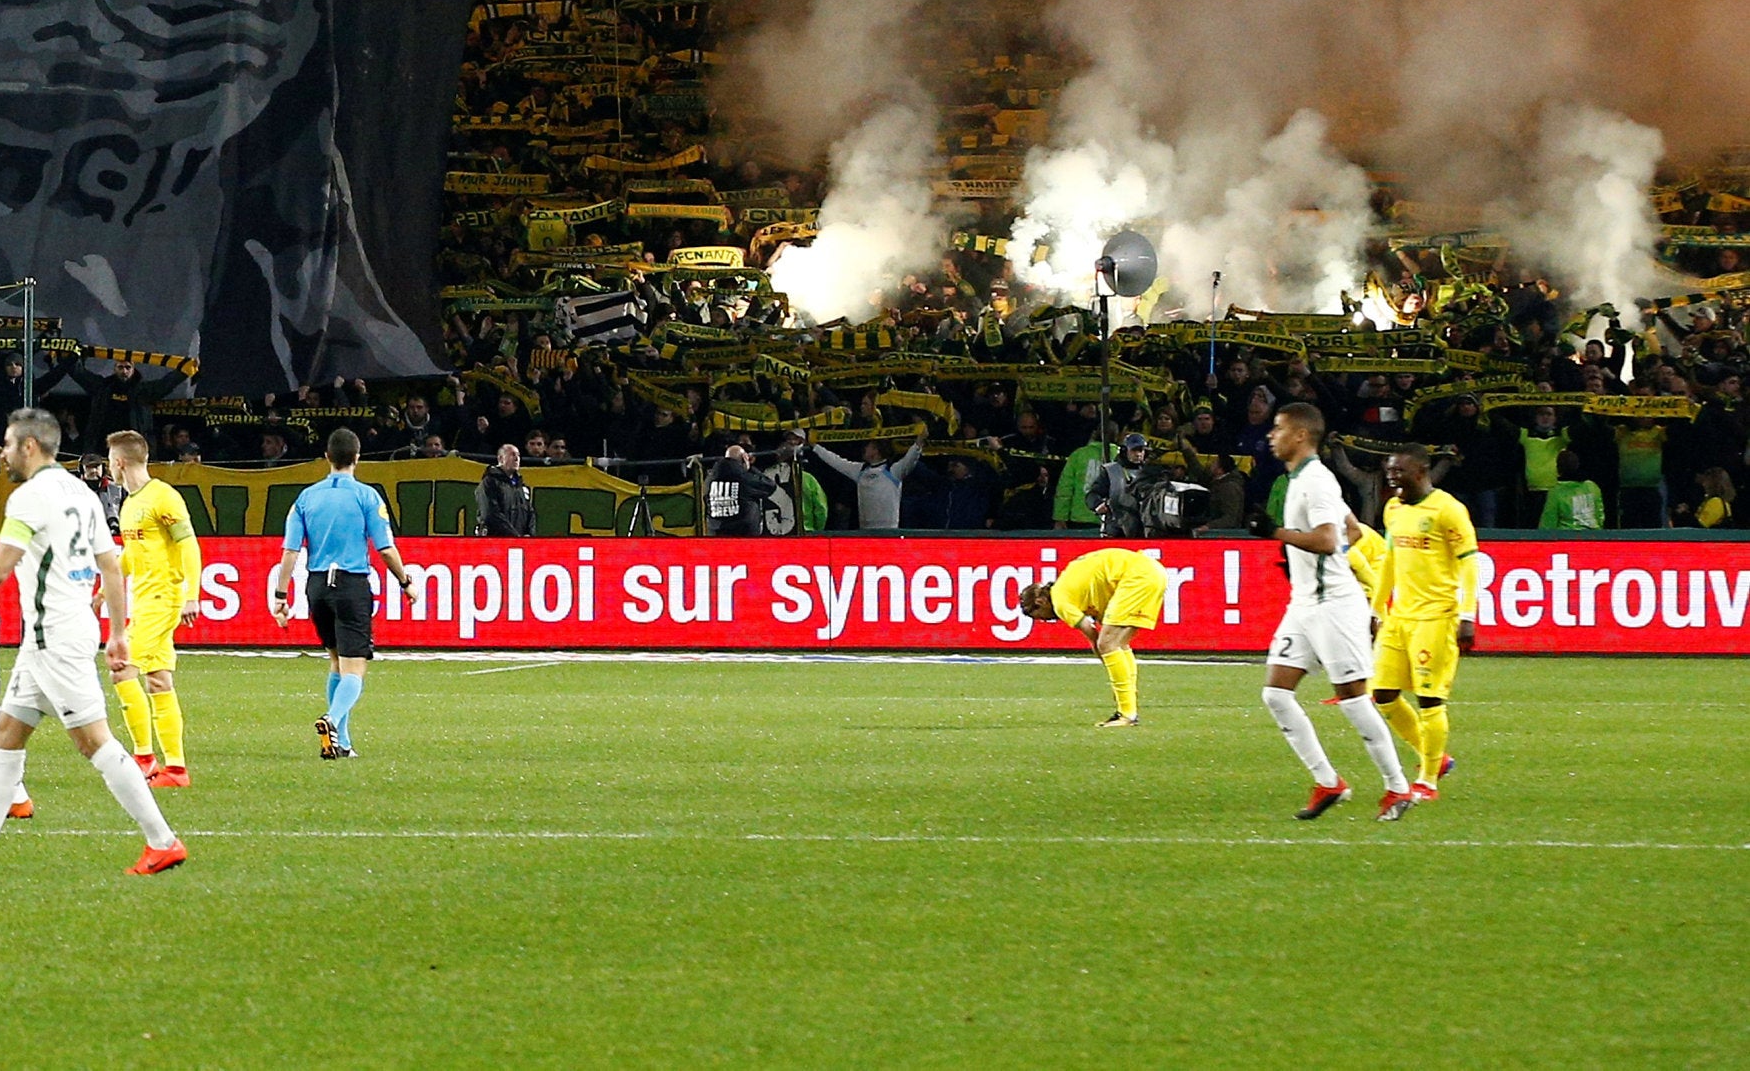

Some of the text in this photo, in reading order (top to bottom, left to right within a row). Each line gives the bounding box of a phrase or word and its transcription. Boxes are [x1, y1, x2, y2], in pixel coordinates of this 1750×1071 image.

[1597, 397, 1628, 408] MUR
[623, 564, 747, 624] sur
[1224, 549, 1240, 624] !
[1278, 635, 1292, 658] 2
